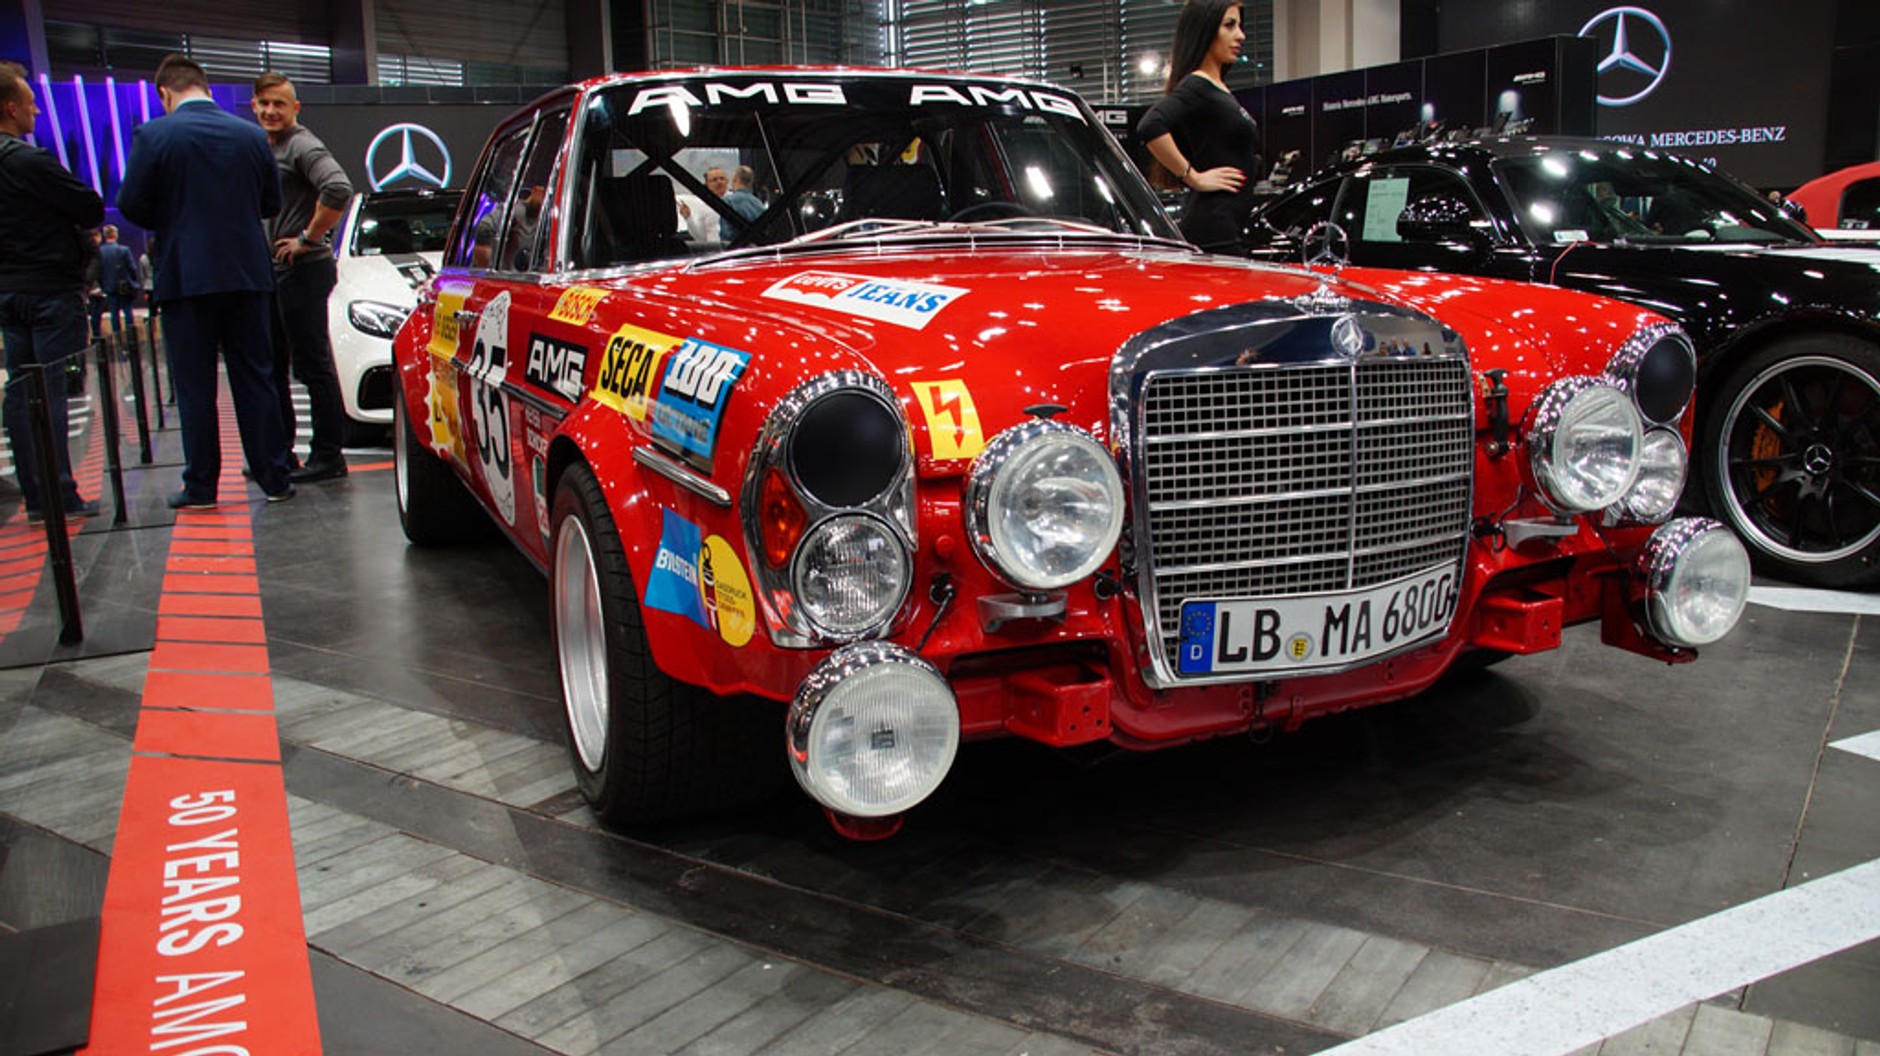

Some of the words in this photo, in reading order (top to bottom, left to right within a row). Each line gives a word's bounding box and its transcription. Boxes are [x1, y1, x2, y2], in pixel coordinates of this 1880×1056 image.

[628, 83, 847, 116] AMG
[909, 83, 1088, 127] AMG
[1651, 126, 1786, 148] MERCEDES-BENZ
[847, 282, 948, 313] JEANS
[527, 340, 585, 399] AMG
[601, 336, 656, 404] SECA
[664, 339, 743, 409] 100
[471, 338, 509, 480] 35
[1217, 608, 1282, 664] LB
[1321, 600, 1371, 657] MA
[1382, 573, 1452, 643] 6800
[1190, 645, 1203, 660] D
[168, 789, 237, 827] 50
[156, 828, 245, 957] YEARS
